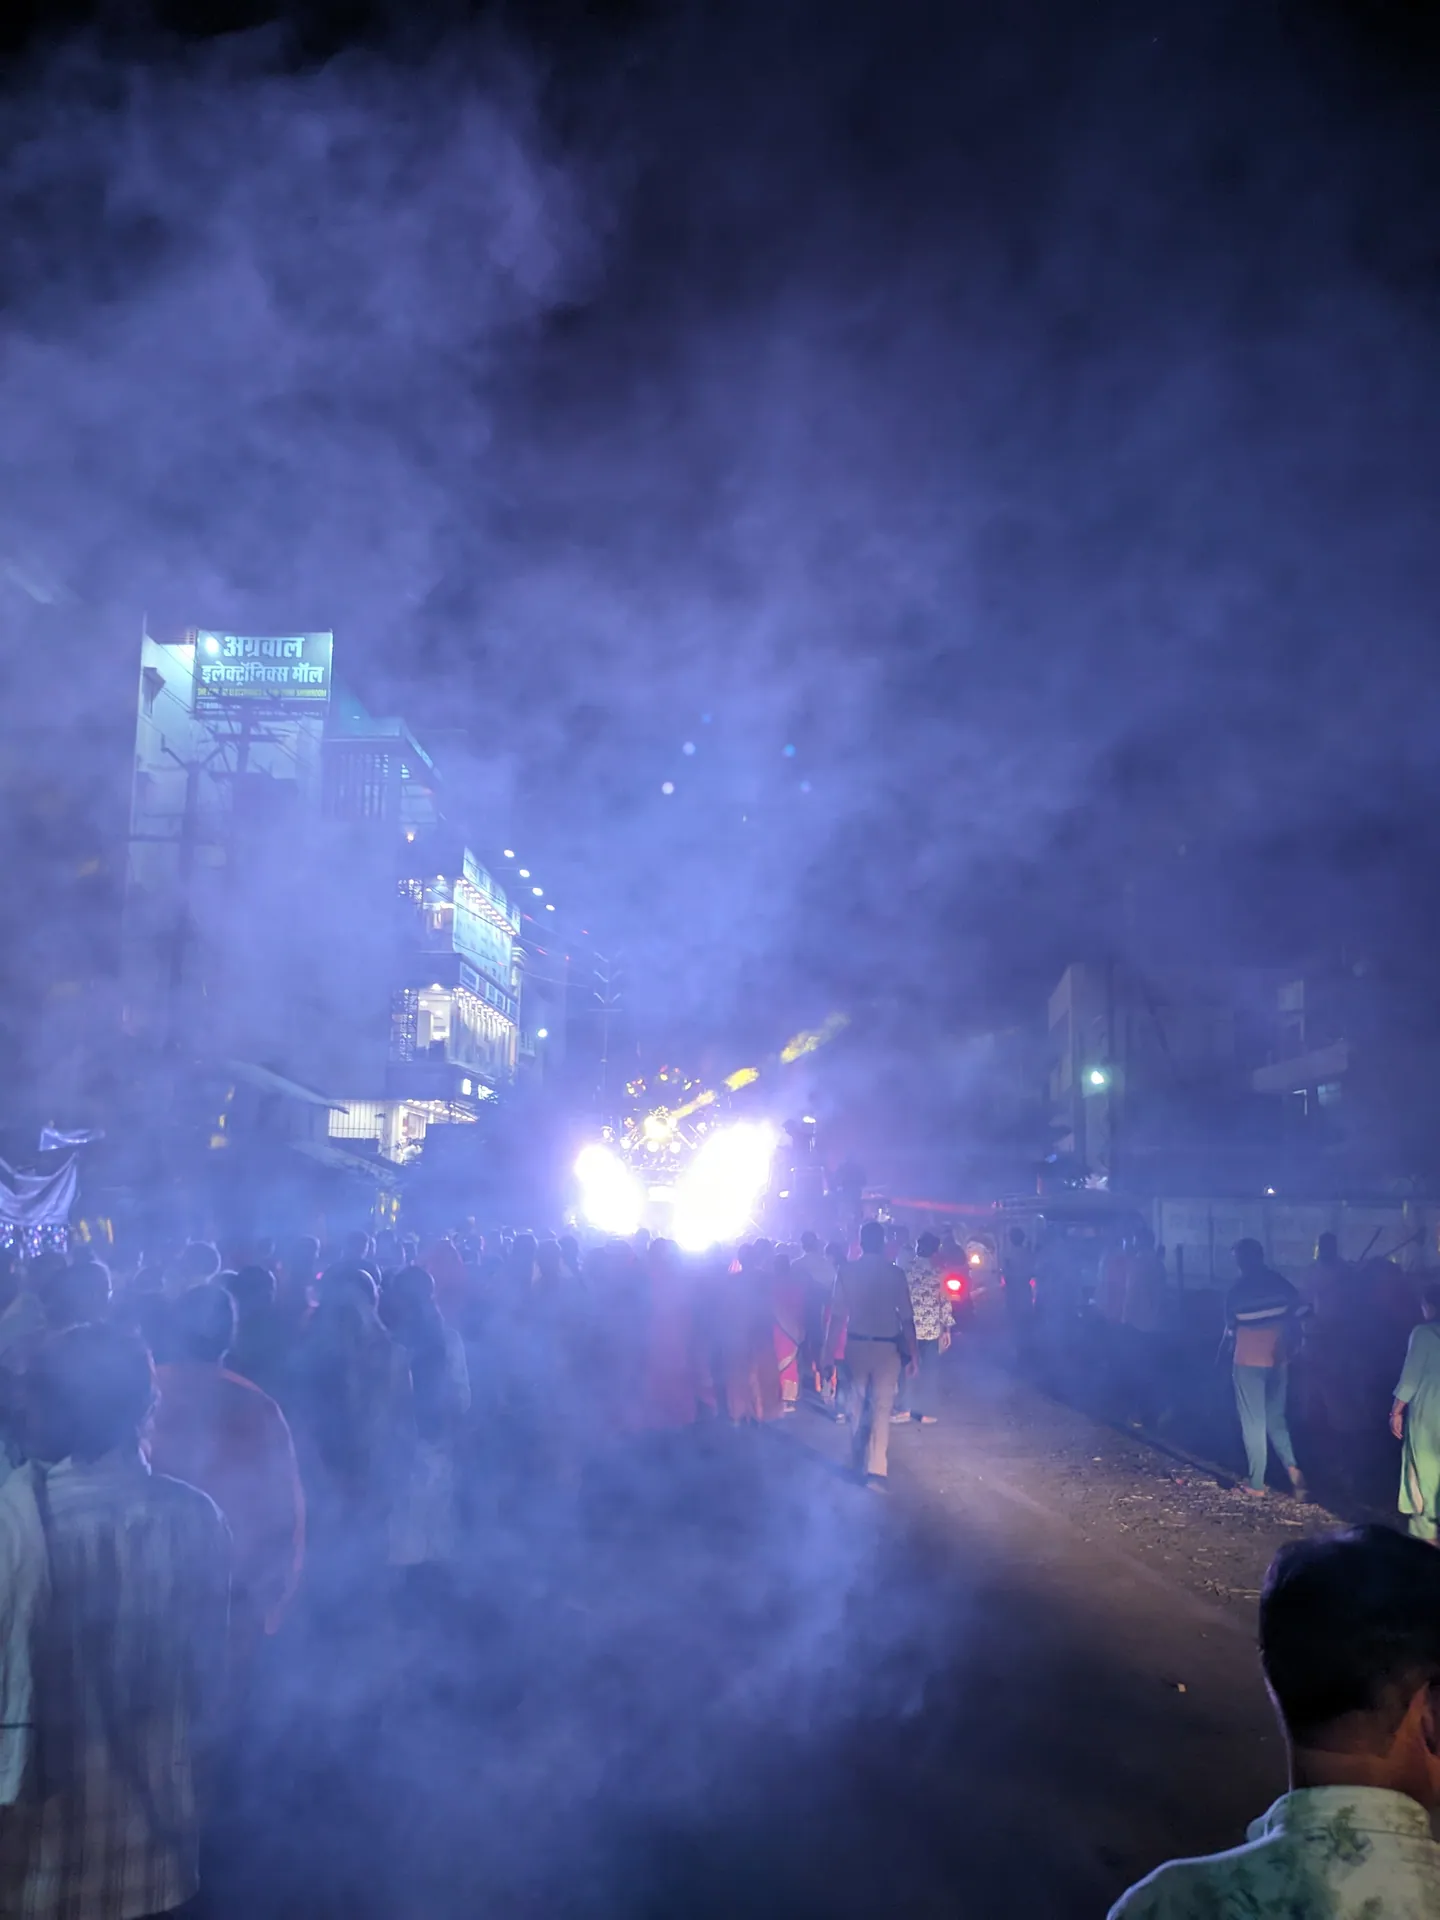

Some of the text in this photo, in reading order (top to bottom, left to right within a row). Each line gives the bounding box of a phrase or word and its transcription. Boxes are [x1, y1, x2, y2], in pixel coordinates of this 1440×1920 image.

[224, 636, 305, 657] अग्रवाल
[201, 661, 325, 686] इलेक्ट्रॉनिक्स मॉल
